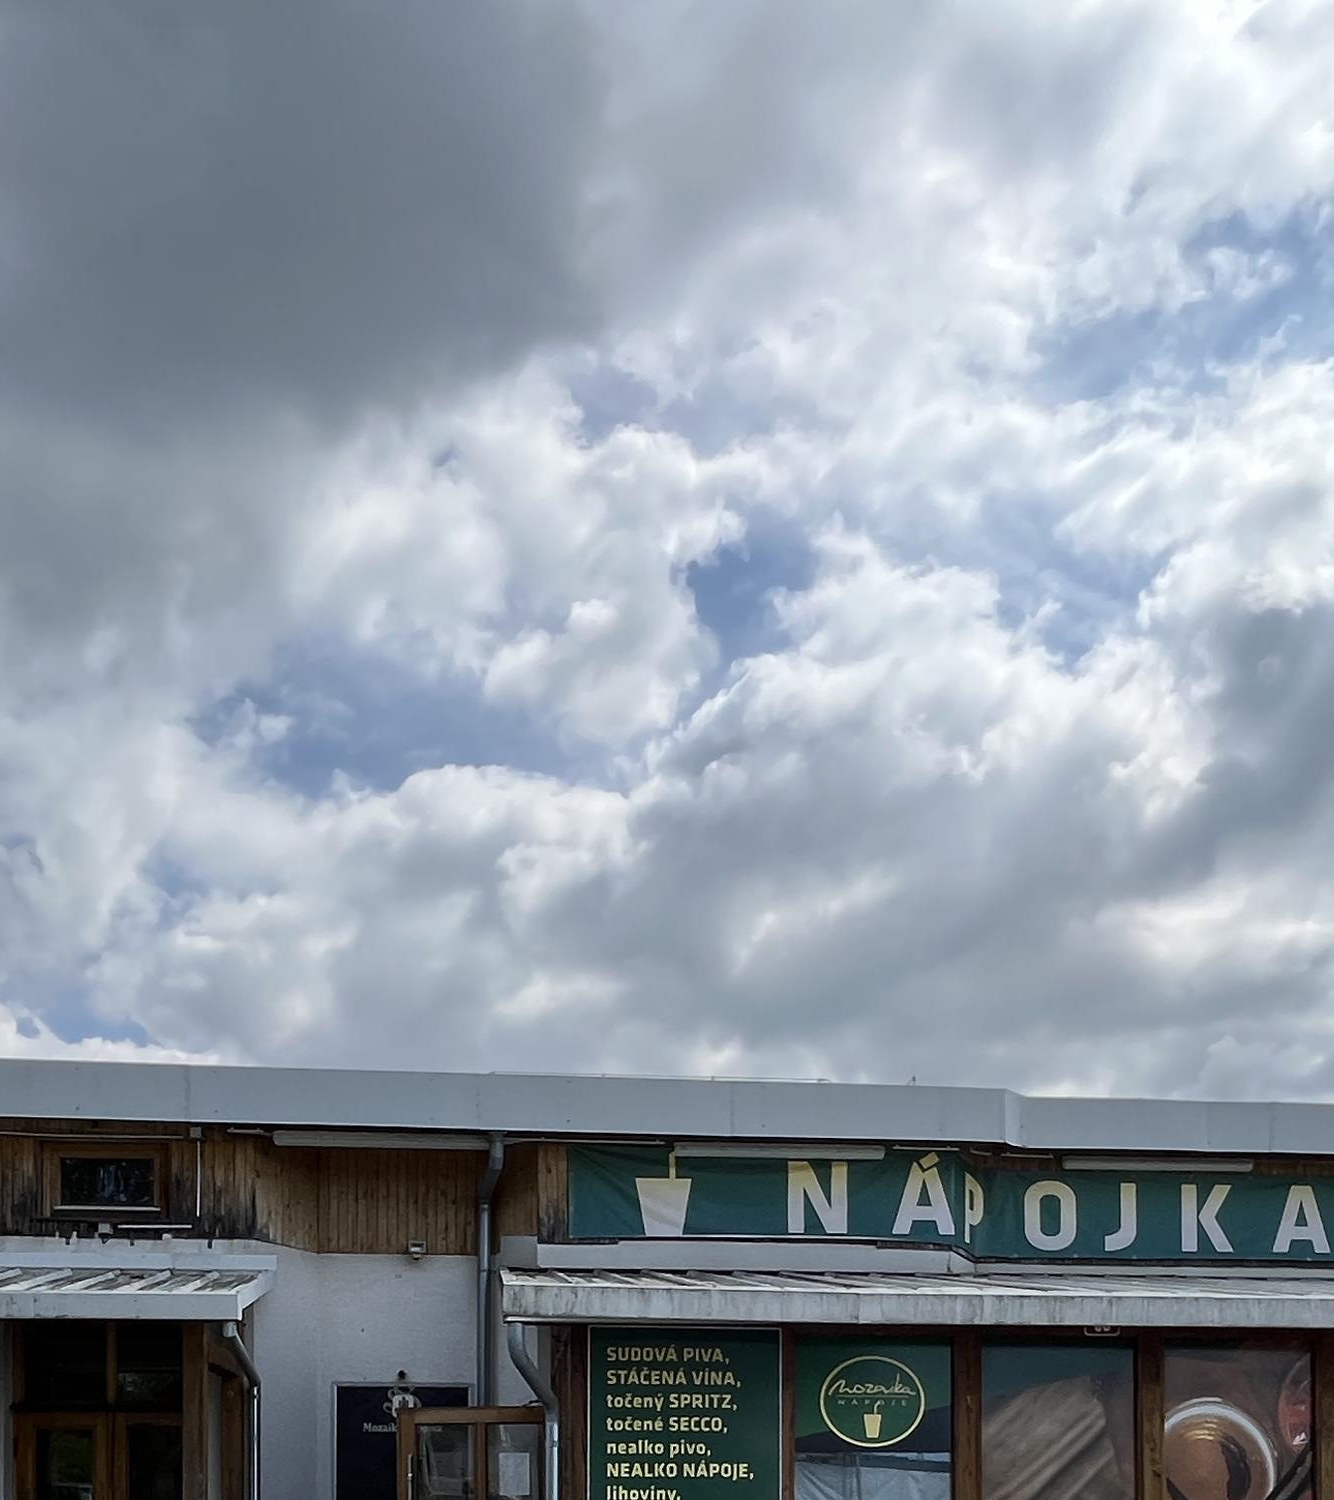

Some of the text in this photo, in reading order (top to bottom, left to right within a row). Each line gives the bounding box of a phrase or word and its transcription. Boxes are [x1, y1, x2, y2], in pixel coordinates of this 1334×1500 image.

[786, 1152, 1331, 1256] NÁPOJKA
[606, 1345, 730, 1365] SUDOVÁ PIVA,
[606, 1367, 741, 1388] STÁČENÁ VÍNA,
[606, 1392, 738, 1412] točený SPRITZ,
[606, 1414, 728, 1434] točené SECCO,
[606, 1439, 711, 1459] nealko pivo,
[606, 1459, 755, 1480] NEALKO NÁPOJE,
